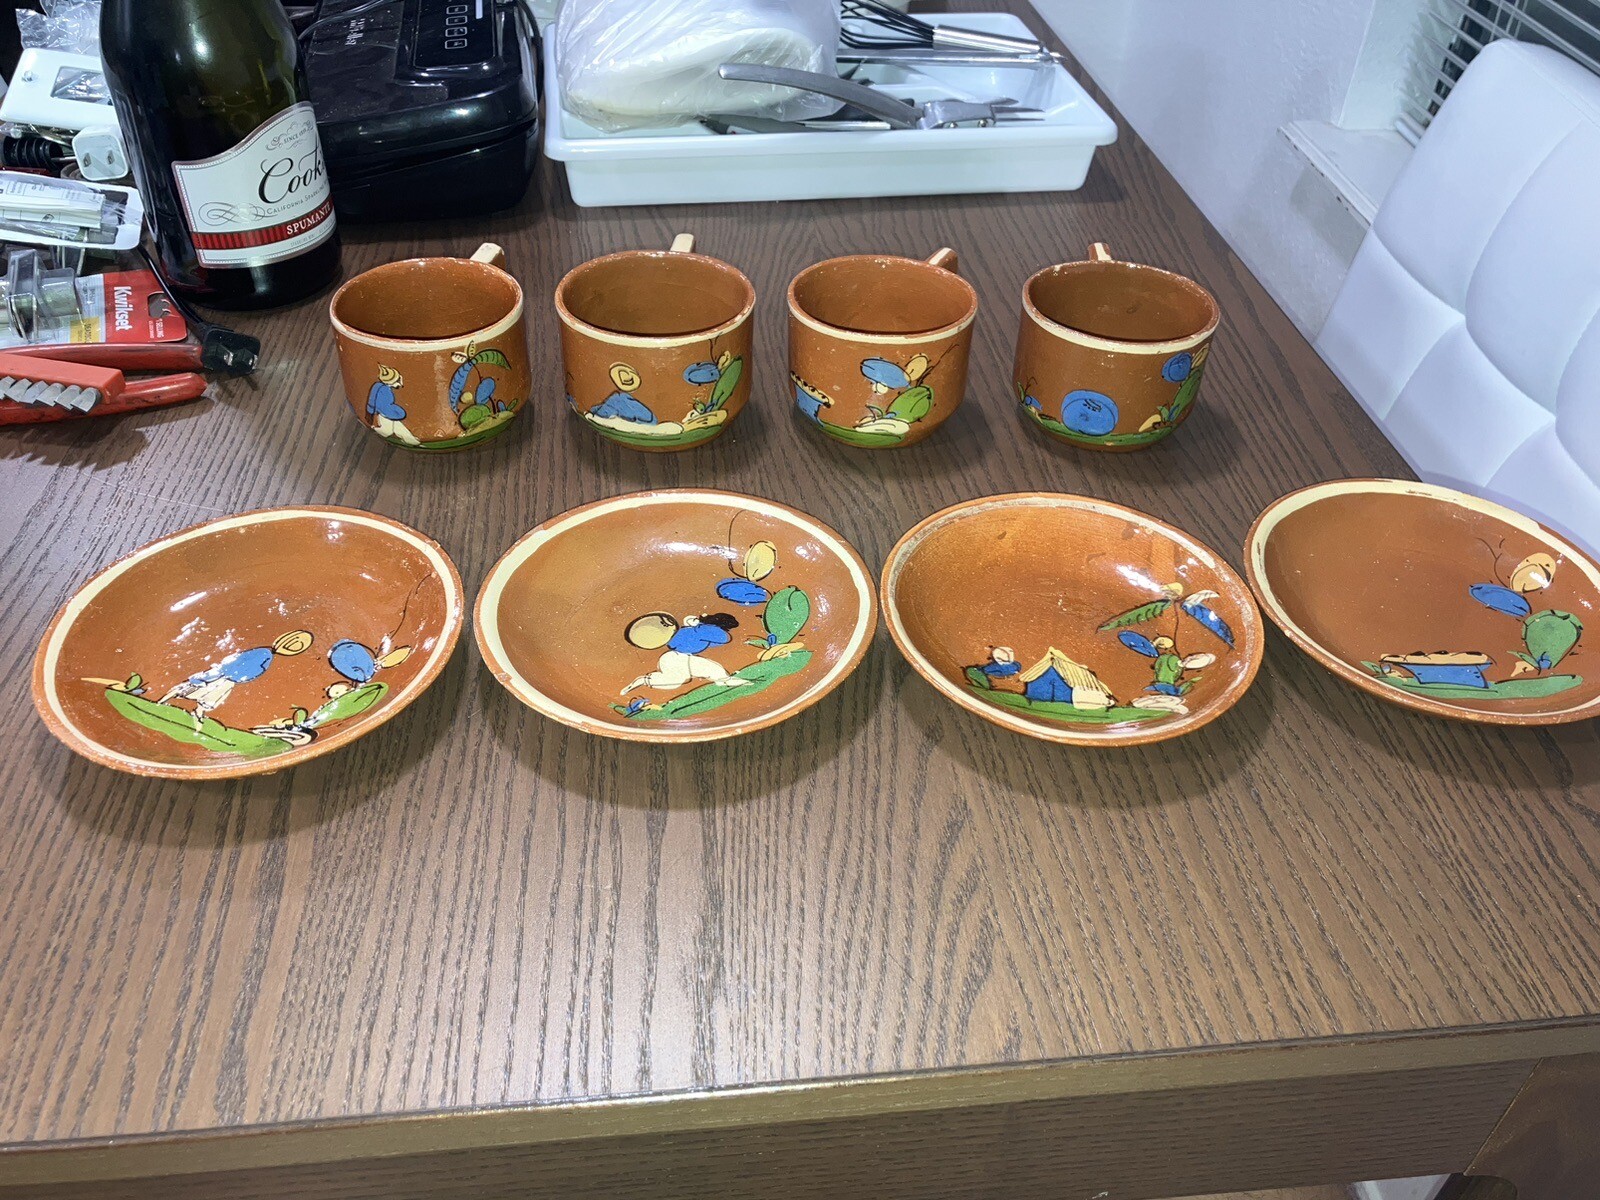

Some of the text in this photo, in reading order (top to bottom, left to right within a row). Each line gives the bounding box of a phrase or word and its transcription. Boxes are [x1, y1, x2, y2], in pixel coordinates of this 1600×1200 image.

[266, 199, 304, 215] CALIFORNIA
[286, 200, 332, 235] SPUMANTE
[114, 286, 133, 331] Kwikset
